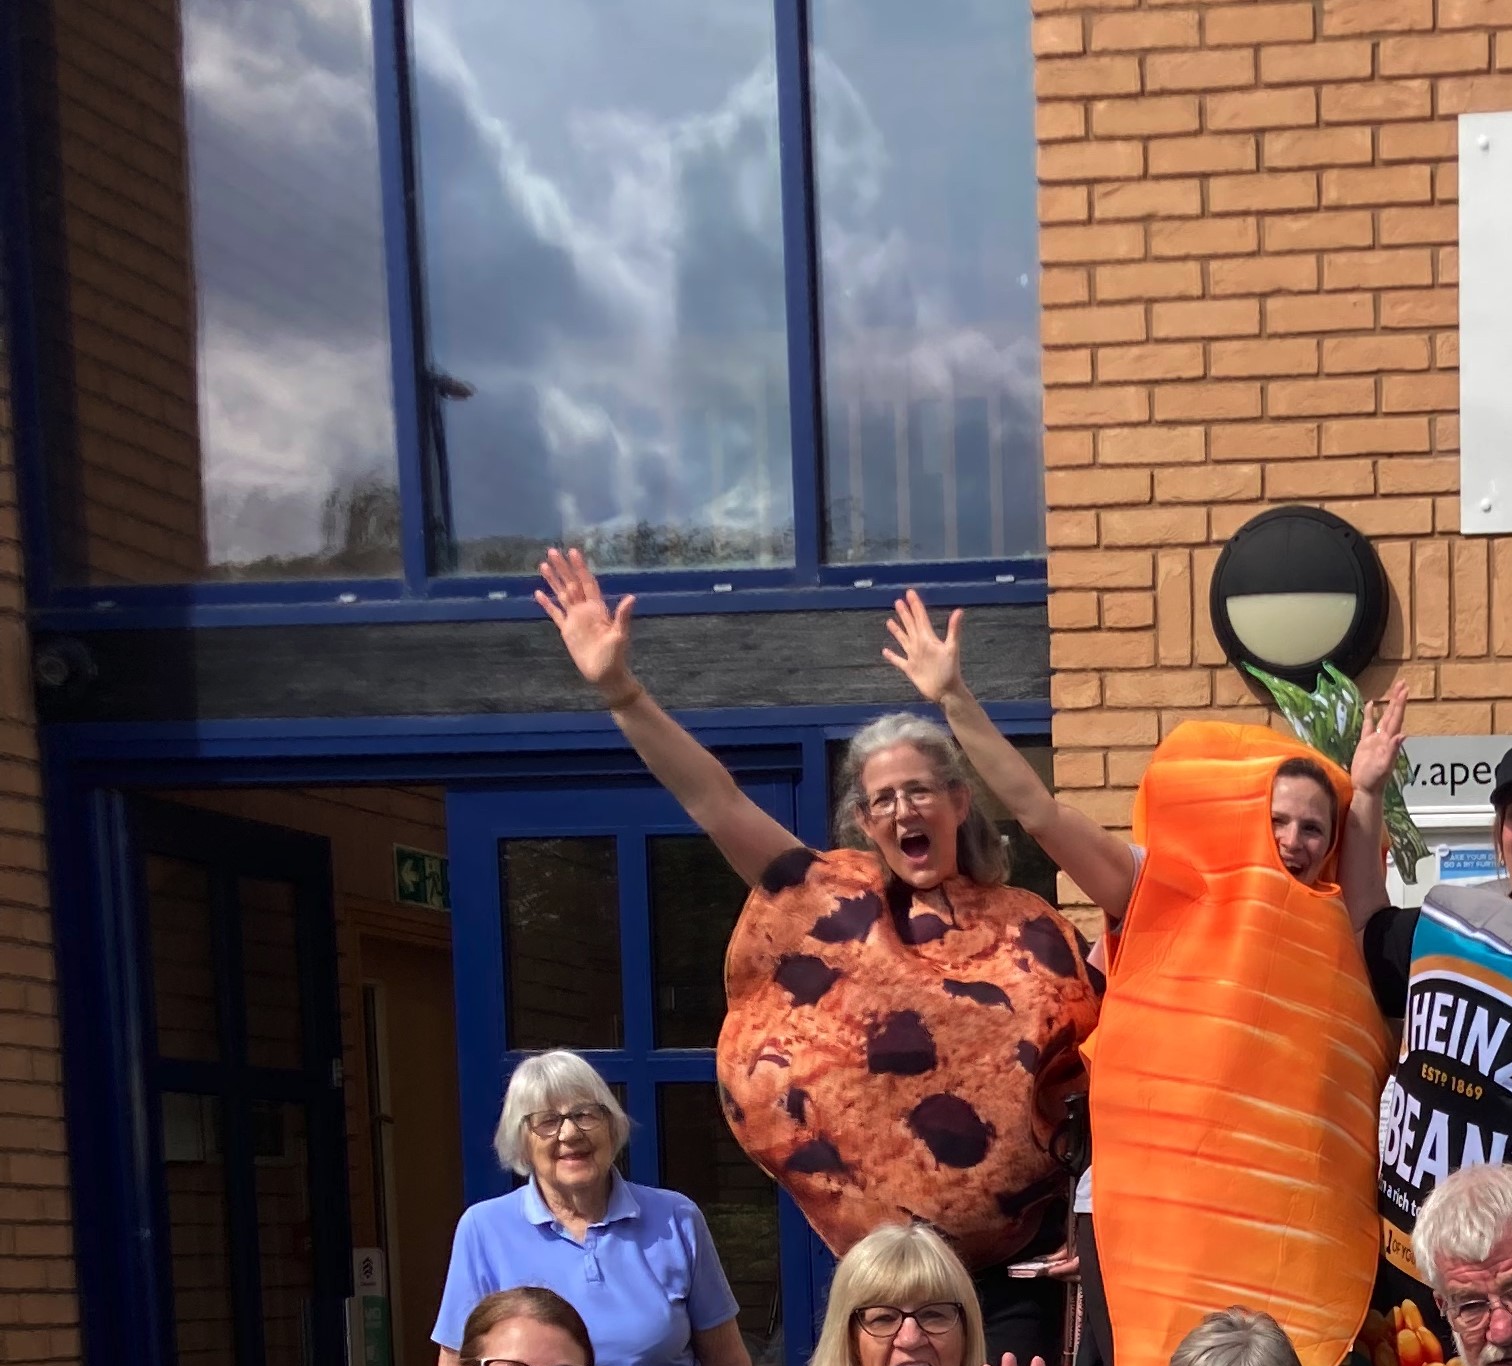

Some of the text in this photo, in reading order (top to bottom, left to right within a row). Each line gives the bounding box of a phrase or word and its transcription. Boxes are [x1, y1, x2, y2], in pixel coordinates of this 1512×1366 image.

[1451, 1076, 1483, 1100] 1869
[1387, 1185, 1393, 1198] a
[1393, 1187, 1409, 1213] rich
